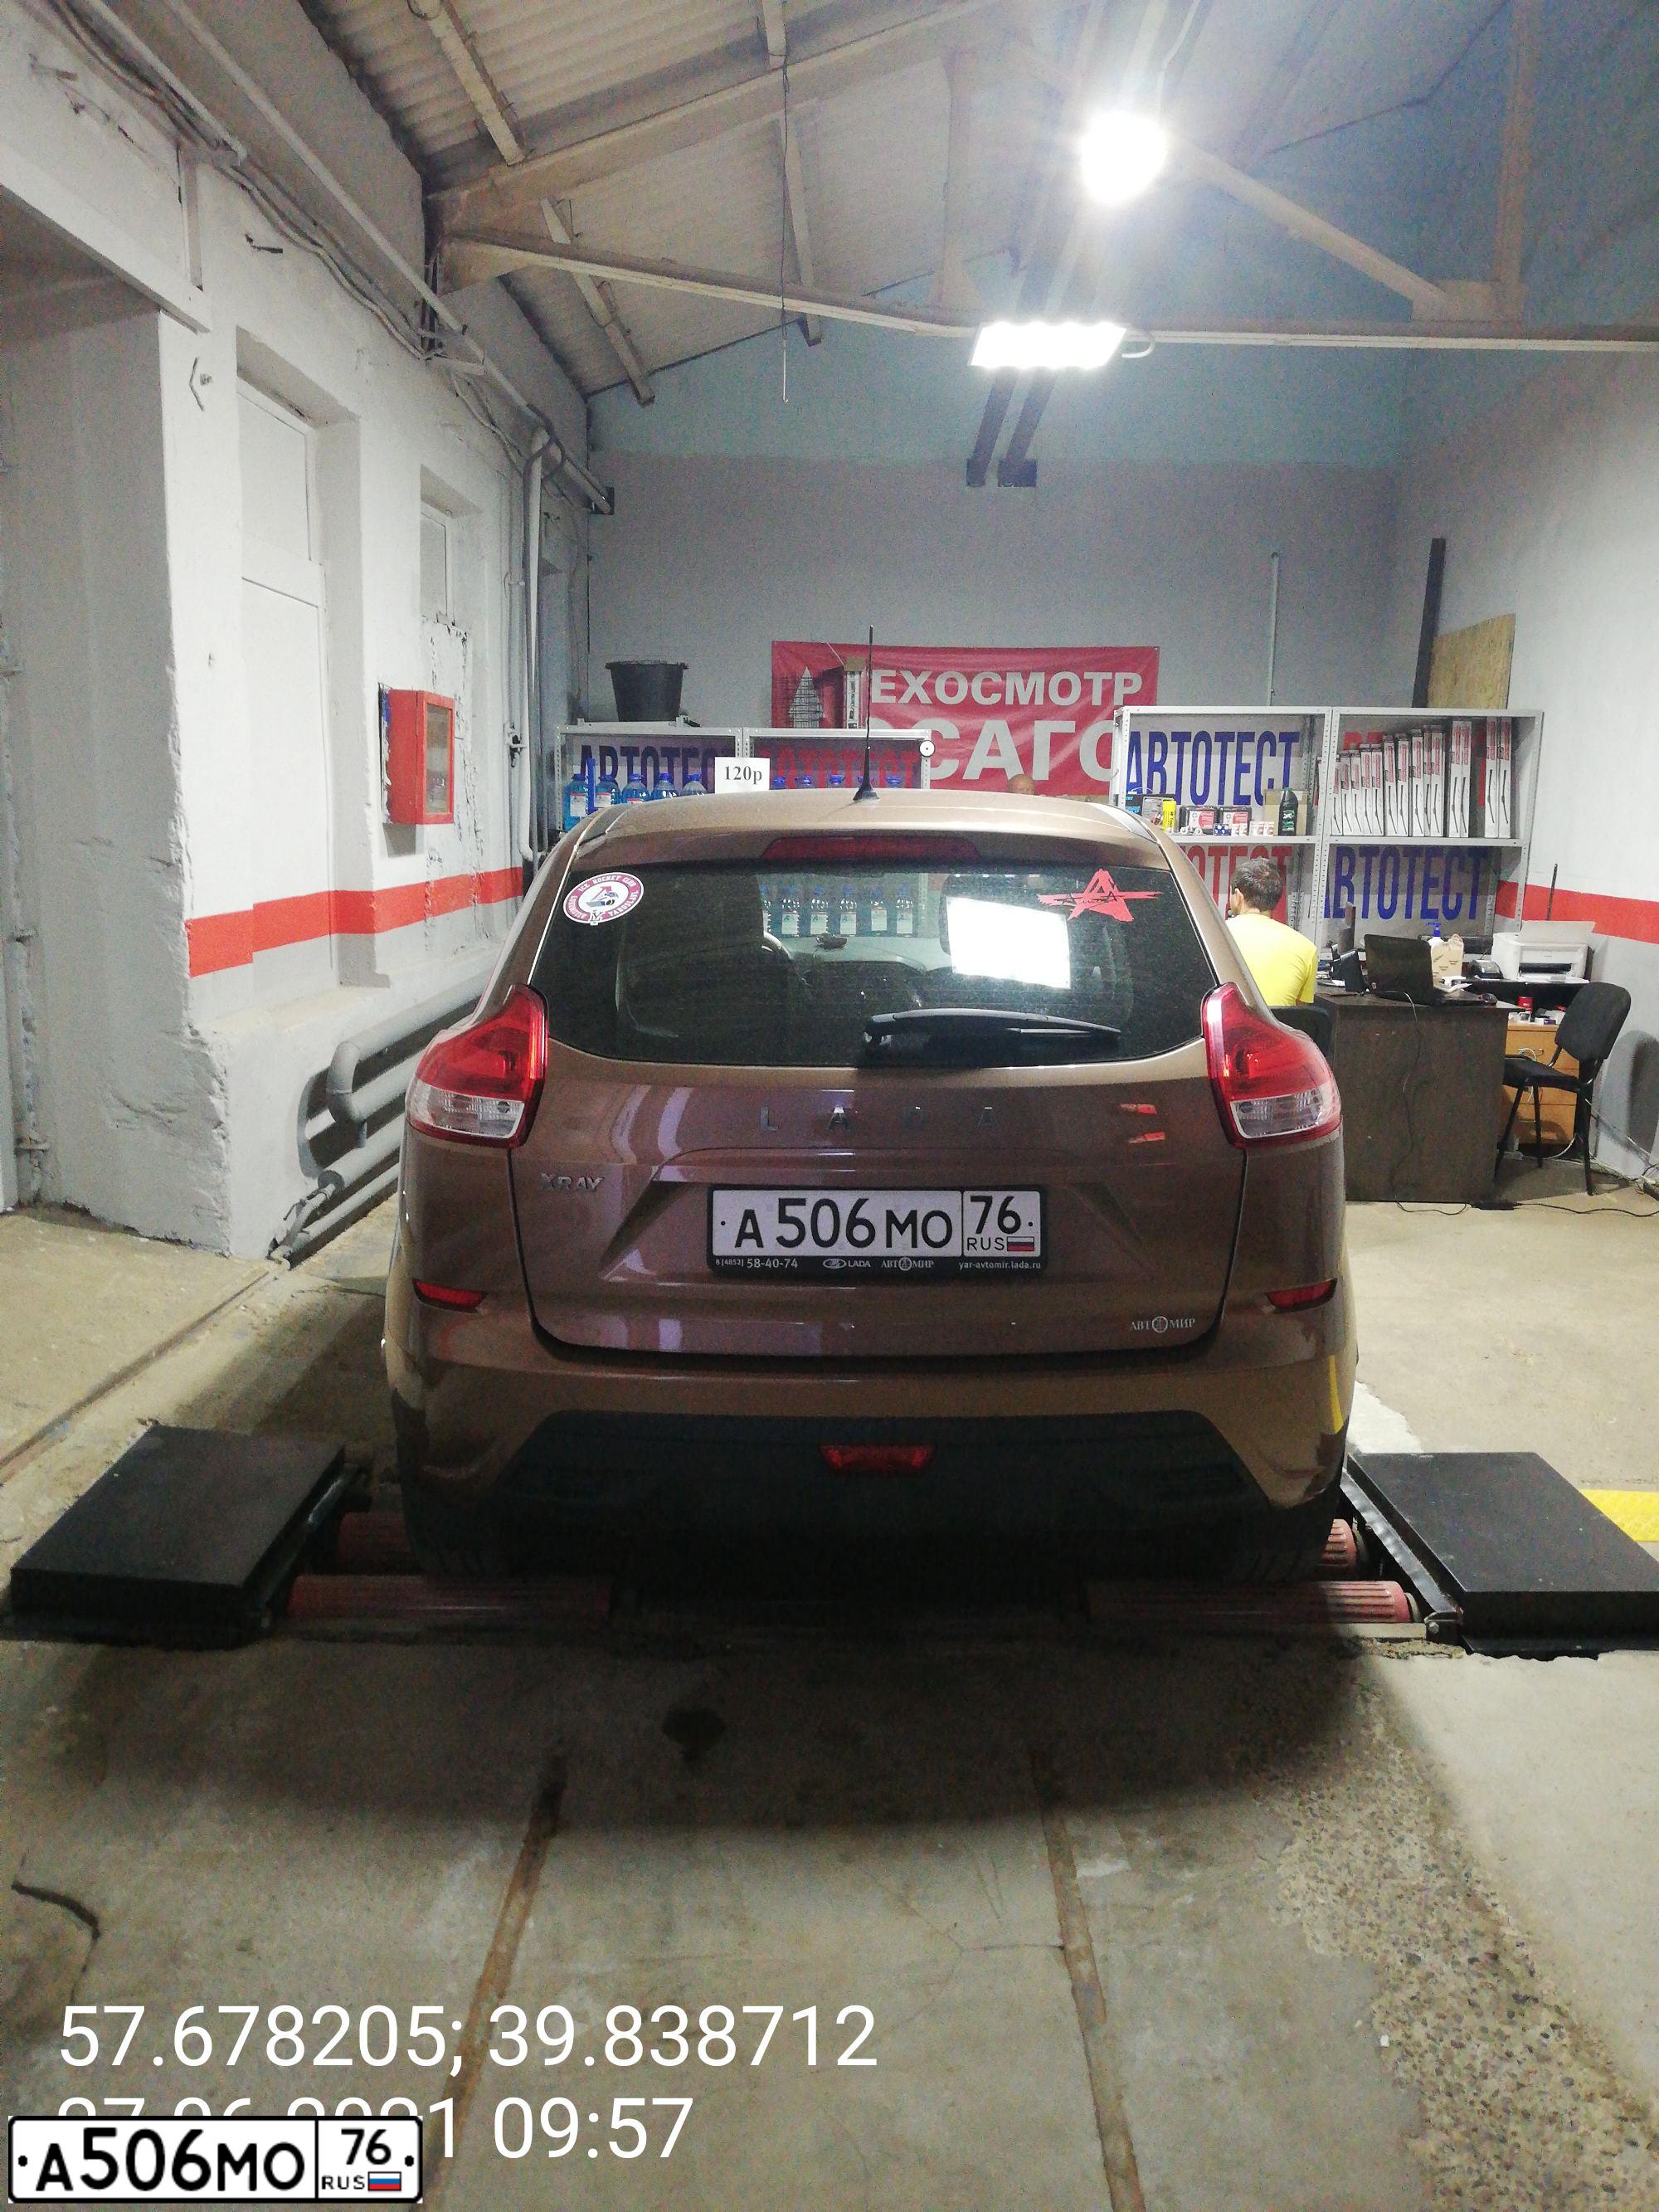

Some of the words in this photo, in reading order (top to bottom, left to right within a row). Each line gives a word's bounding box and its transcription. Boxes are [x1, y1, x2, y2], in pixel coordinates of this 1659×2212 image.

[868, 669, 1143, 706] ЕХОСМОТР
[867, 717, 1117, 782] САГО
[1126, 730, 1301, 806] АВТОТЕСТ
[580, 743, 736, 797] АВТОТЕ
[734, 1198, 953, 1248] А506МО
[970, 1195, 1022, 1235] 76
[967, 1236, 1005, 1251] RUS
[747, 1258, 798, 1269] 58-40-74
[848, 1259, 871, 1268] LADA
[958, 1259, 1041, 1271] yar-avtomir.lada.ru
